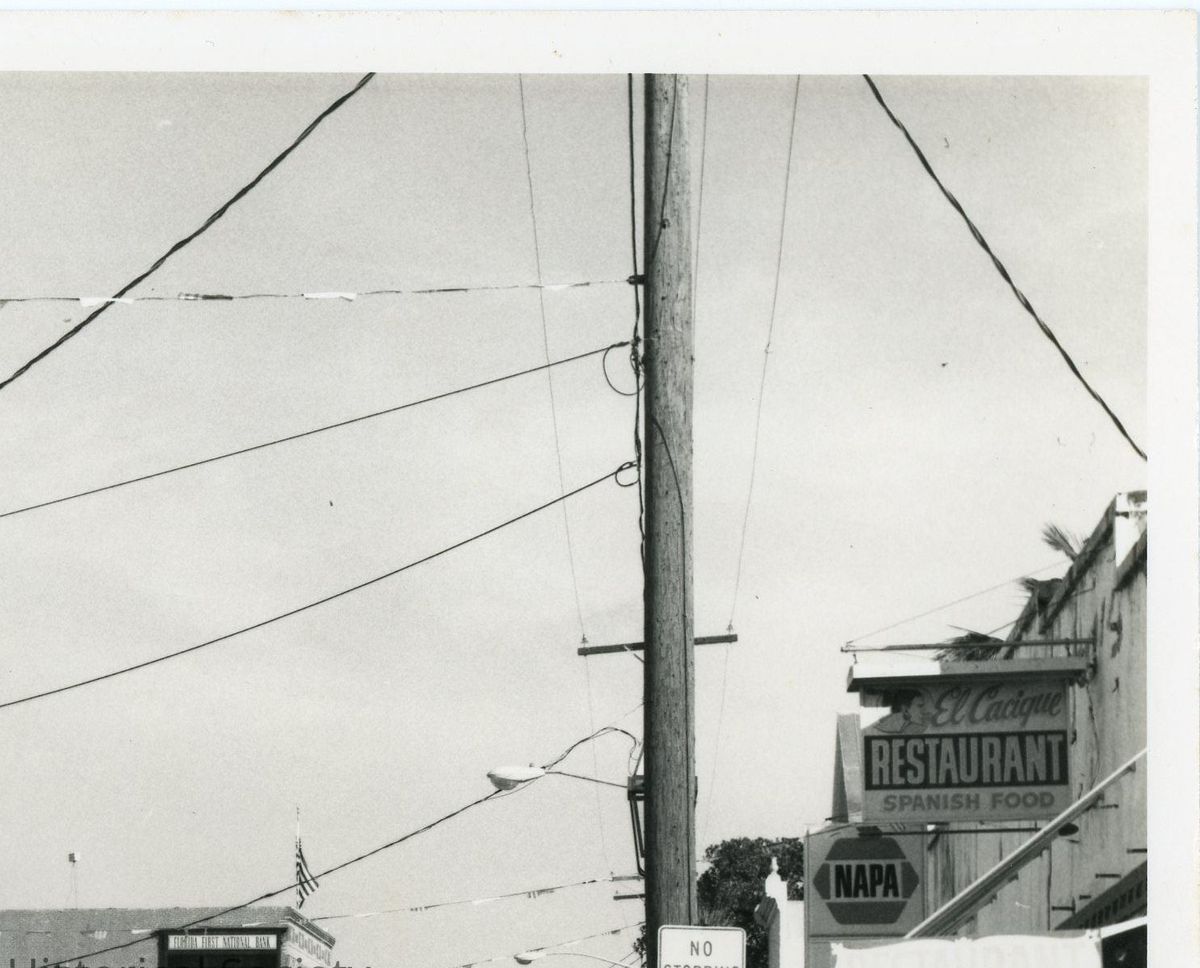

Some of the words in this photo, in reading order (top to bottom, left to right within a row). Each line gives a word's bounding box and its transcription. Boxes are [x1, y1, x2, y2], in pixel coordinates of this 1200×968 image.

[930, 686, 969, 727] El
[970, 682, 1063, 727] Cacique
[870, 733, 1065, 786] RESTAURANT
[882, 793, 981, 812] SPANISH
[990, 792, 1056, 809] FOOD
[835, 863, 899, 898] NAPA
[202, 936, 220, 949] FIRST
[222, 936, 251, 949] NATIONAL
[255, 936, 271, 949] BANK
[690, 940, 712, 956] NO
